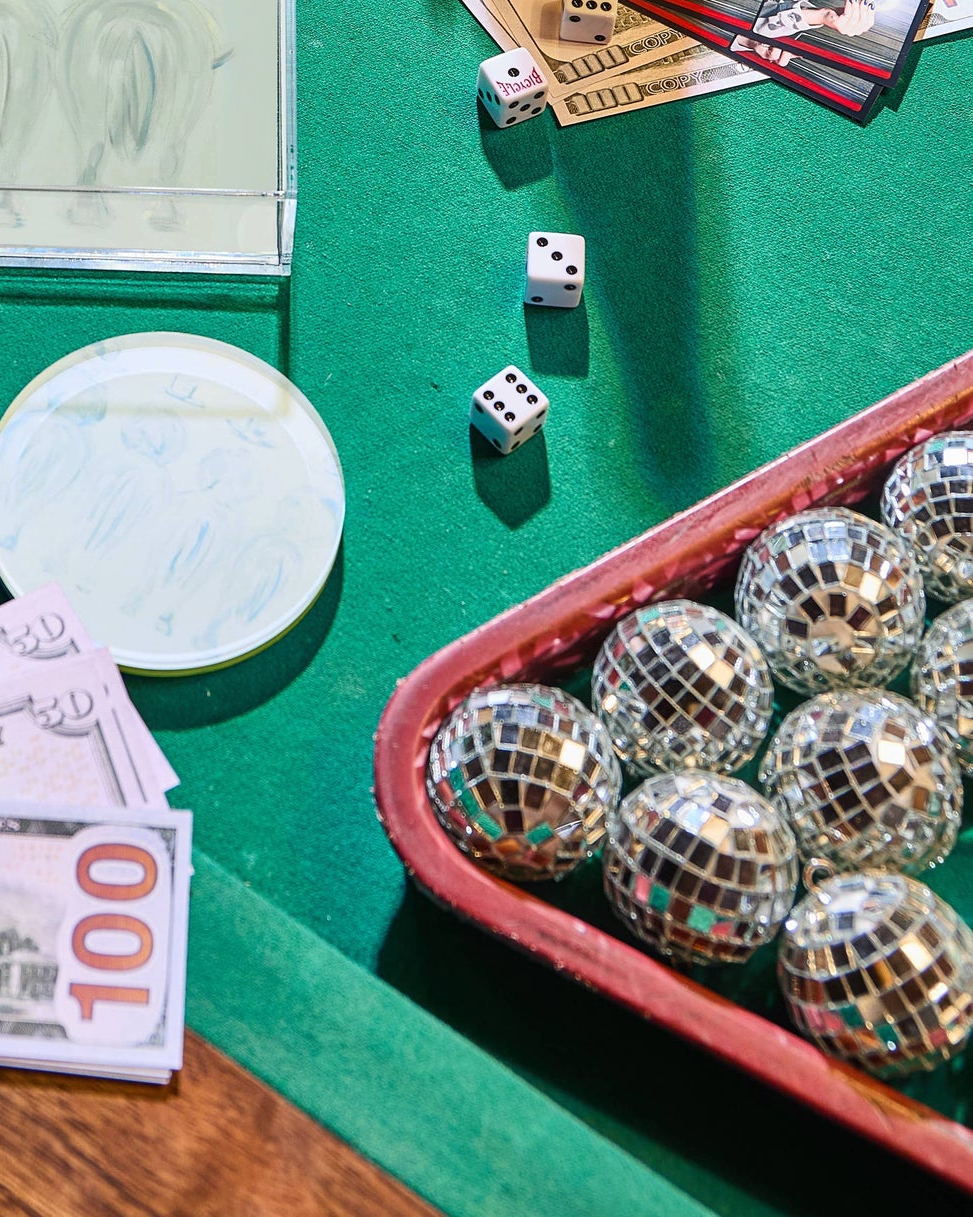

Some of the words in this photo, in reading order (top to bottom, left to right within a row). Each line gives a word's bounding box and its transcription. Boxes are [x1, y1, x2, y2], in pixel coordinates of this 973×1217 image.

[629, 28, 684, 55] COPY
[495, 65, 543, 96] BICYCLE
[645, 70, 703, 94] COPY
[69, 842, 158, 1021] 100
